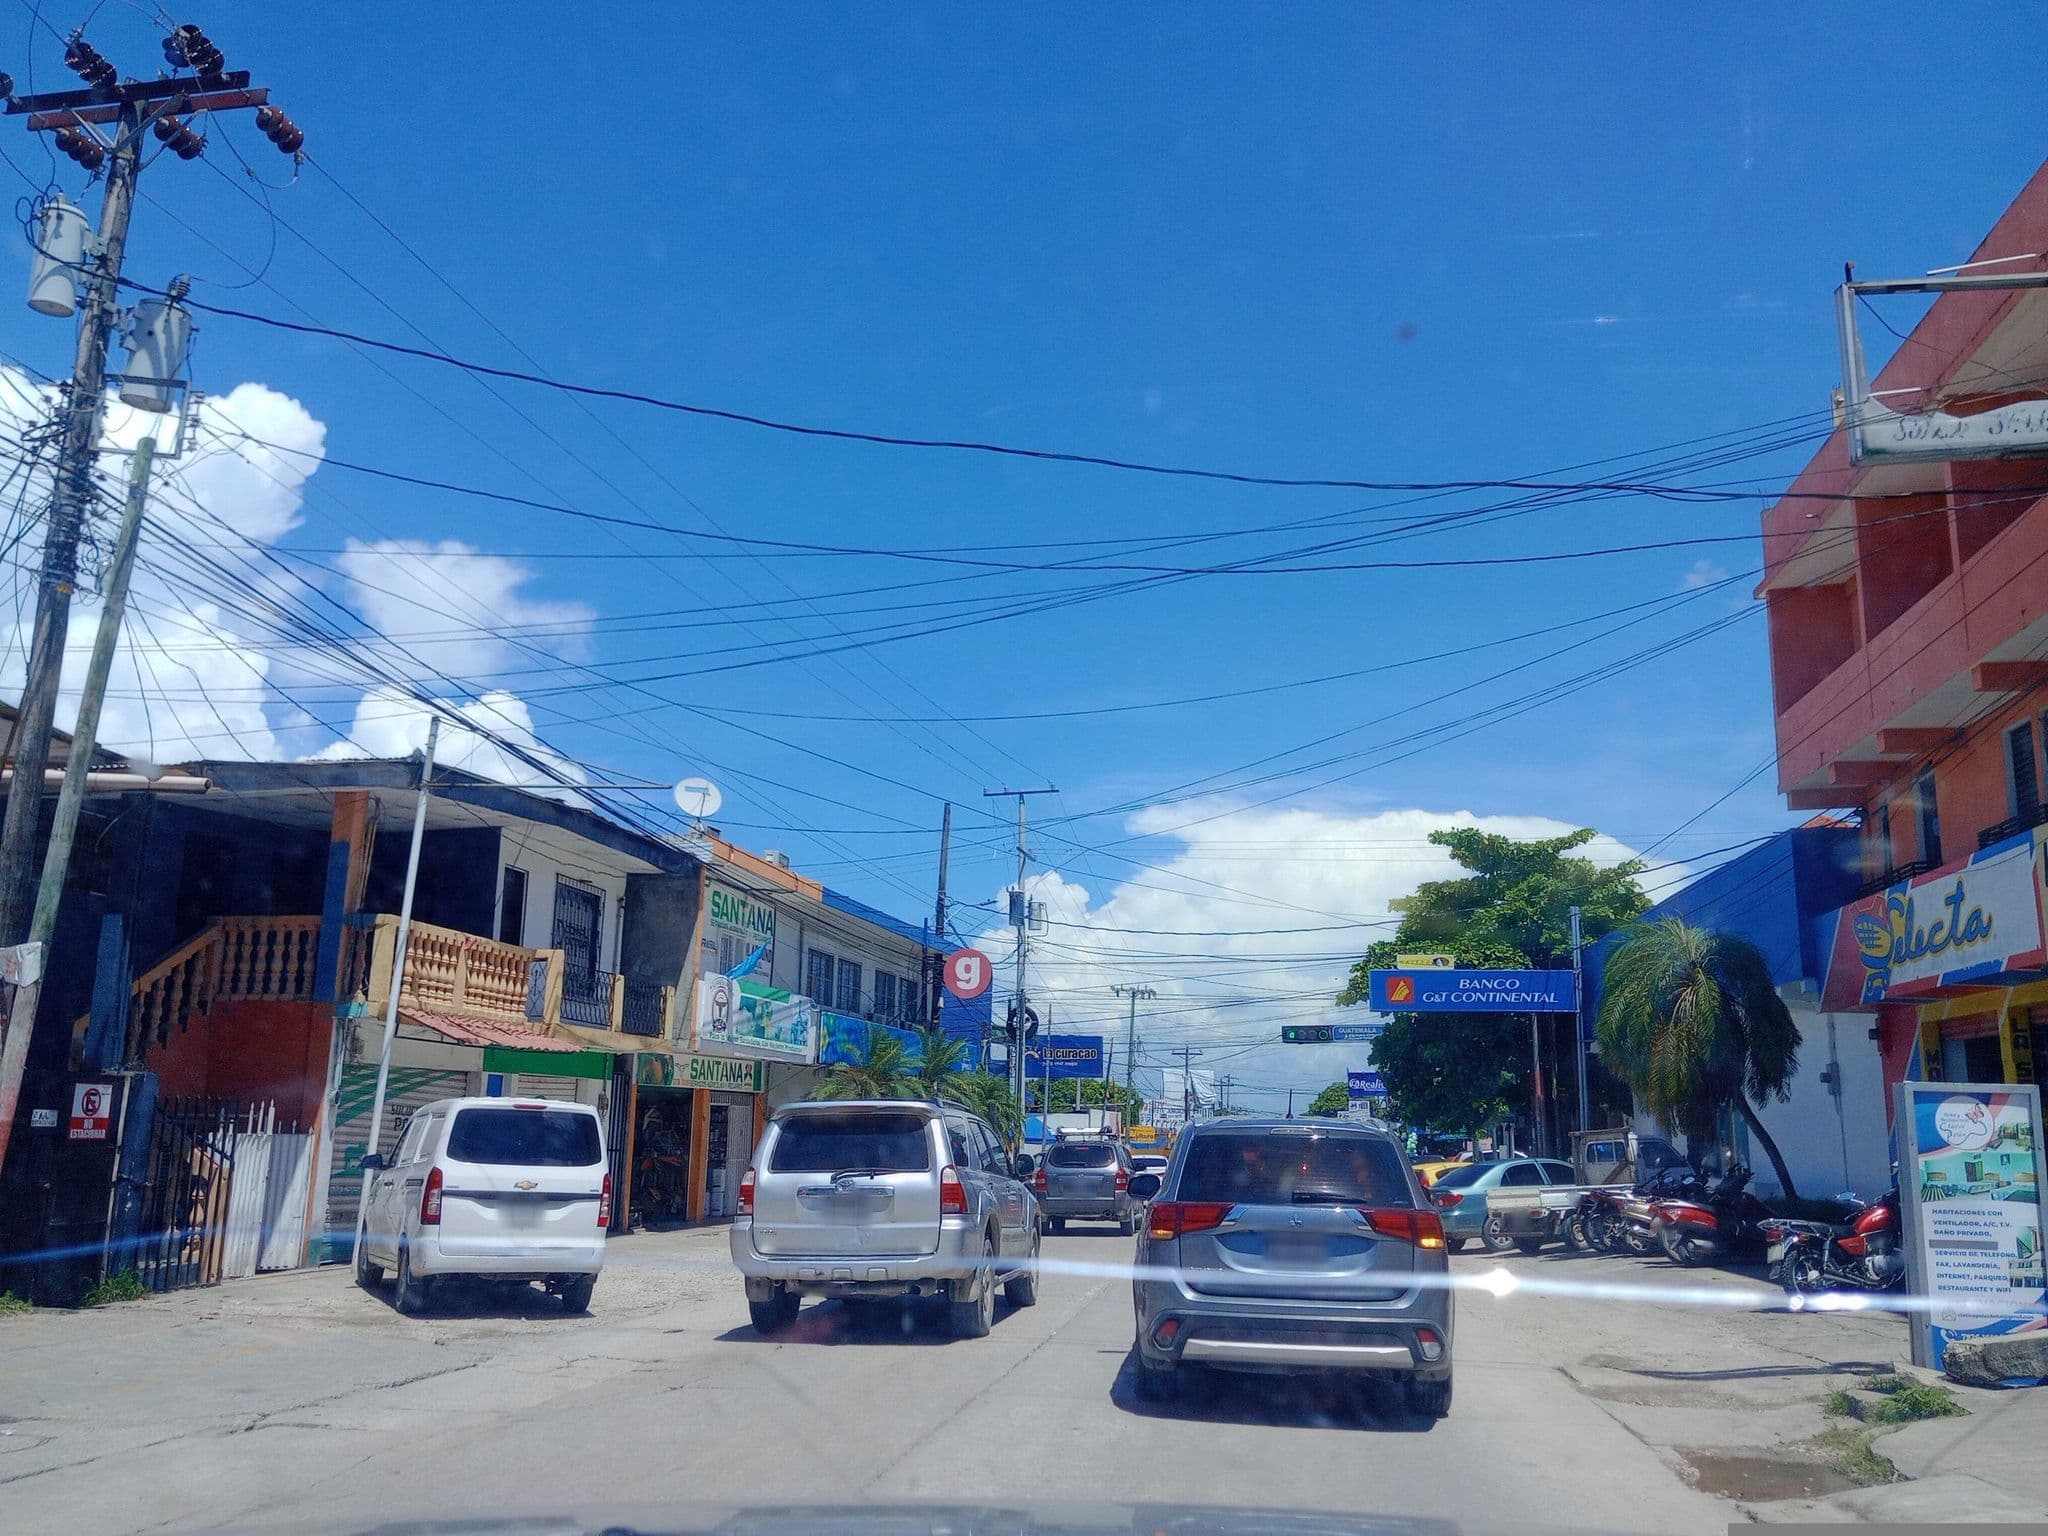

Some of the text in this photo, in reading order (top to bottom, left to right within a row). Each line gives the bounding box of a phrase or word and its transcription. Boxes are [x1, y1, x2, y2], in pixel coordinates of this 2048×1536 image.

[711, 890, 774, 936] SANTANA
[955, 956, 980, 990] g
[1459, 978, 1520, 989] BANCO
[1422, 991, 1559, 1003] G&T CONTINENTAL
[1055, 1048, 1098, 1060] curacao
[690, 1058, 744, 1083] SANTANA
[83, 1118, 94, 1129] NO
[1938, 1285, 1988, 1293] RESTAURANTE
